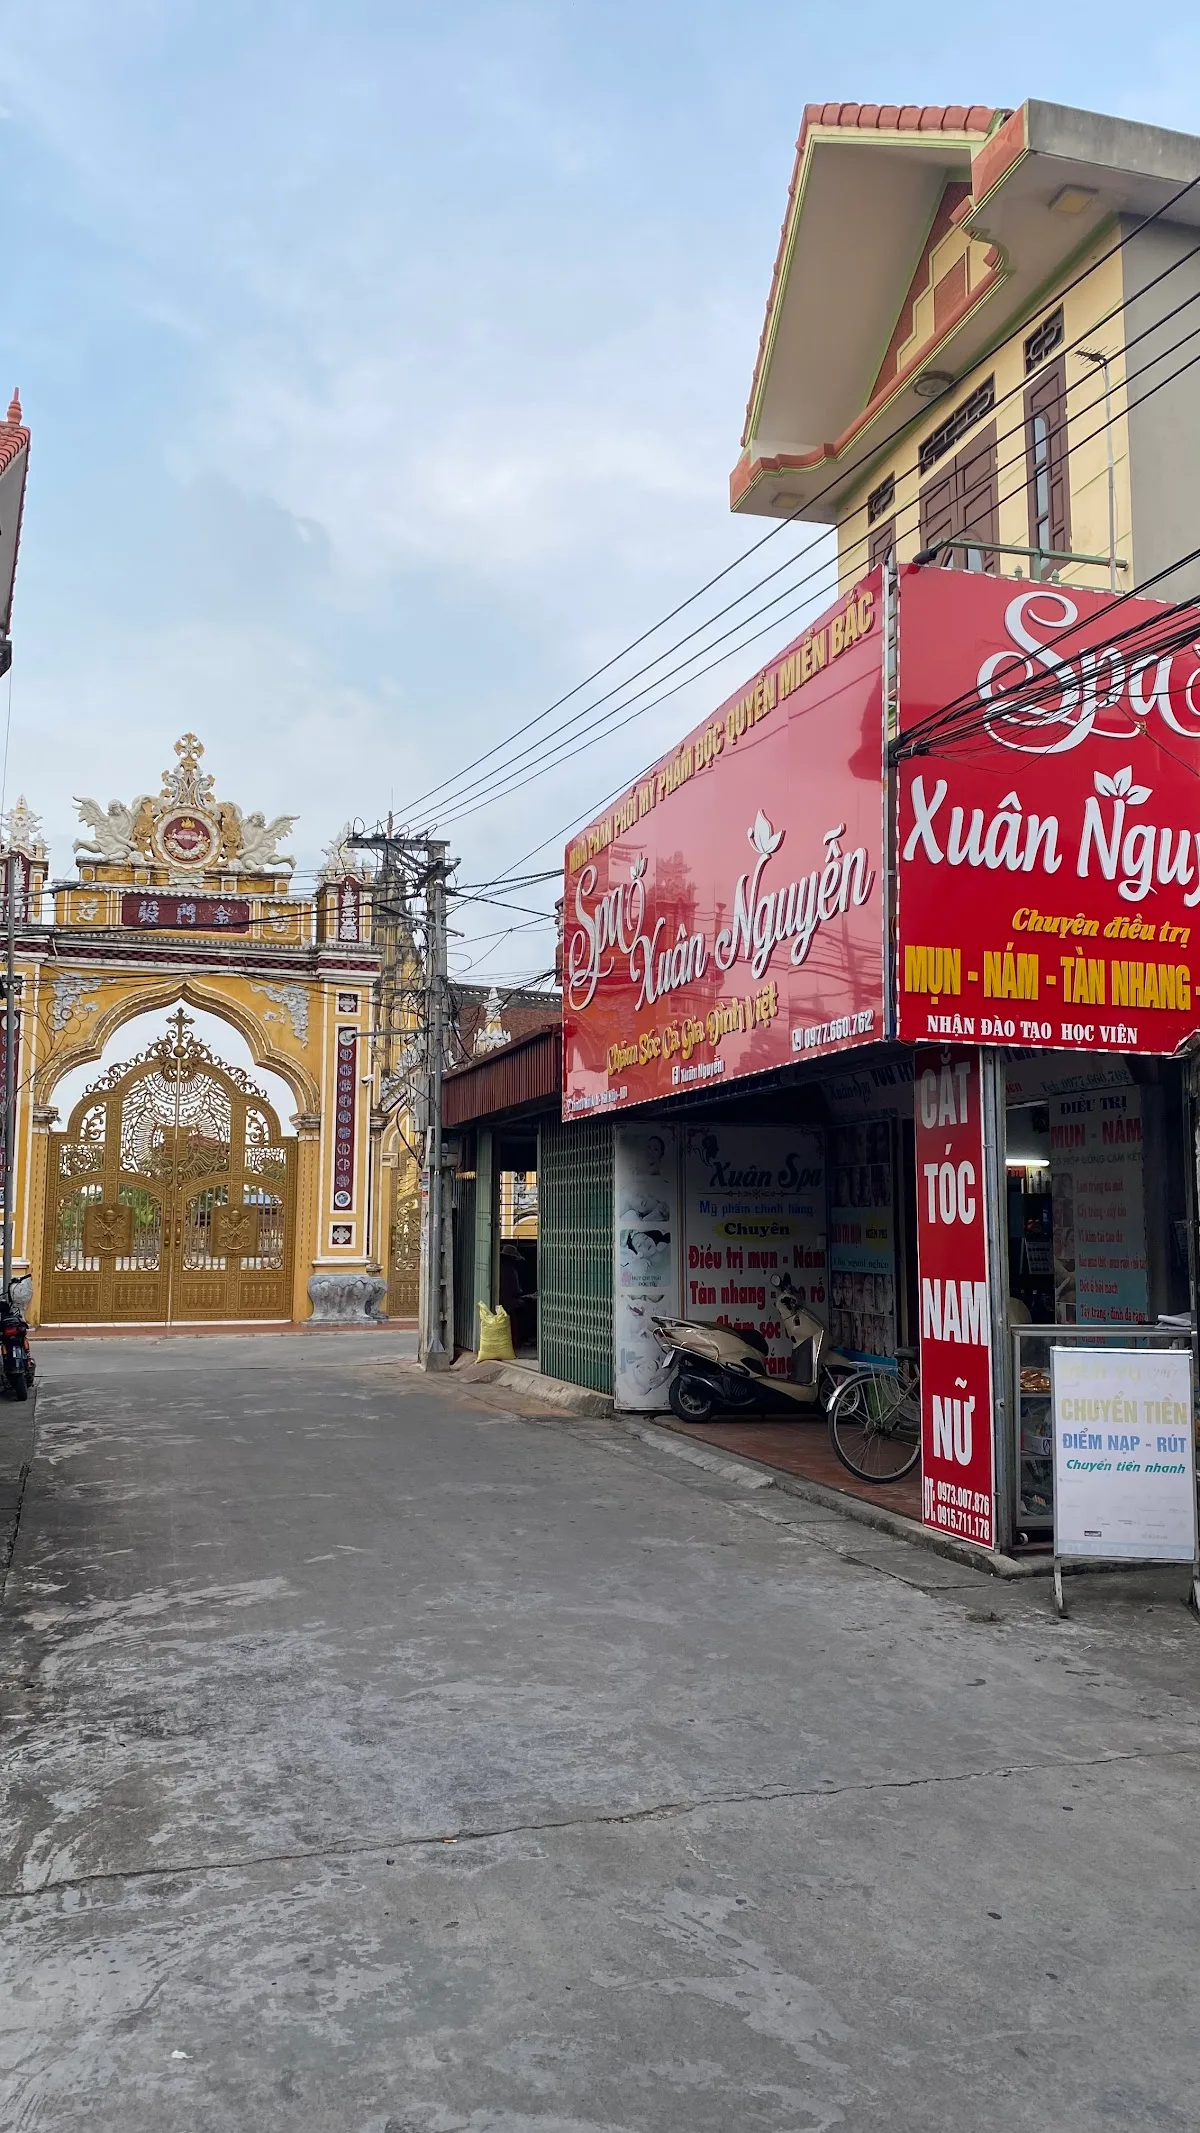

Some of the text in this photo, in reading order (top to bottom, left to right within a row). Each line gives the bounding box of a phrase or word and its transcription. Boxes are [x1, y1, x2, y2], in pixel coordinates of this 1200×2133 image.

[726, 671, 779, 745] QUYỀN
[779, 627, 831, 702] MIỀN
[831, 588, 875, 660] BẮC
[902, 775, 1062, 874] Xuân
[630, 822, 876, 1011] Xuân Nguyễn
[1012, 907, 1191, 949] Chuyên điều trị
[568, 865, 646, 1011] Spa
[905, 945, 961, 1005] MỤN
[984, 942, 1039, 1000] NÁM
[1061, 946, 1105, 1005] TÀN
[1111, 960, 1191, 1011] NHANG
[804, 1009, 874, 1049] 0977.660.762
[927, 1013, 1138, 1044] NHẬN ĐÀO TẠO HỌC VIÊN
[924, 1144, 976, 1225] TÓC
[724, 1221, 790, 1237] Chuyên
[690, 1281, 716, 1304] Tàn
[721, 1279, 766, 1310] nhang
[922, 1278, 985, 1345] NAM
[932, 1377, 976, 1466] NỮ
[1061, 1391, 1188, 1425] CHUYỂN TIỀN
[1062, 1428, 1102, 1451] ĐIỂM
[1108, 1434, 1140, 1455] NẠP
[1157, 1433, 1187, 1453] RÚT
[1145, 1463, 1186, 1474] nhanh
[938, 1481, 989, 1516] 0973.007.876
[938, 1504, 989, 1540] 0915.711.178
